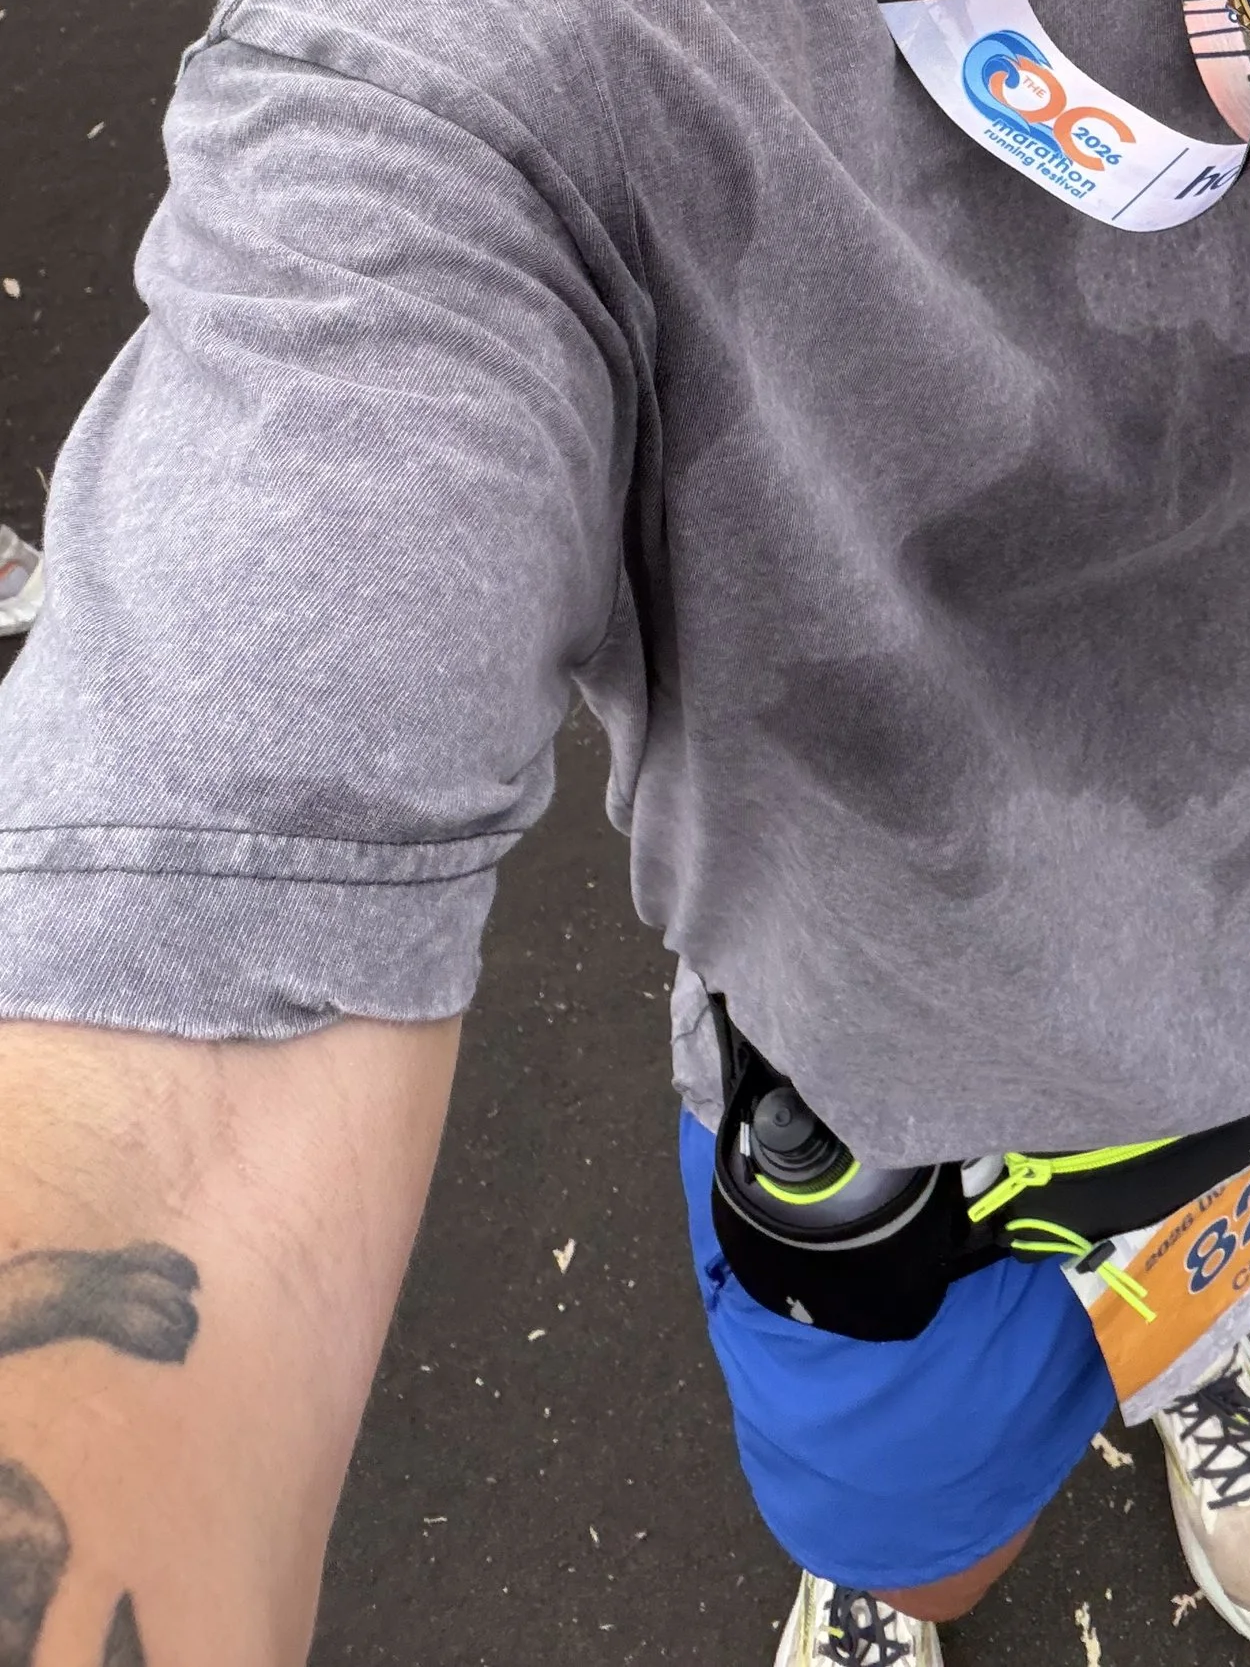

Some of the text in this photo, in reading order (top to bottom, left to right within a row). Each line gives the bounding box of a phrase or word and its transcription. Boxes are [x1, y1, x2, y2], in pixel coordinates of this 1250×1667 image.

[1021, 74, 1048, 99] THE
[983, 126, 1088, 200] running festival
[991, 116, 1097, 192] marathon
[1071, 125, 1123, 166] 2026
[1145, 1211, 1195, 1273] 2026
